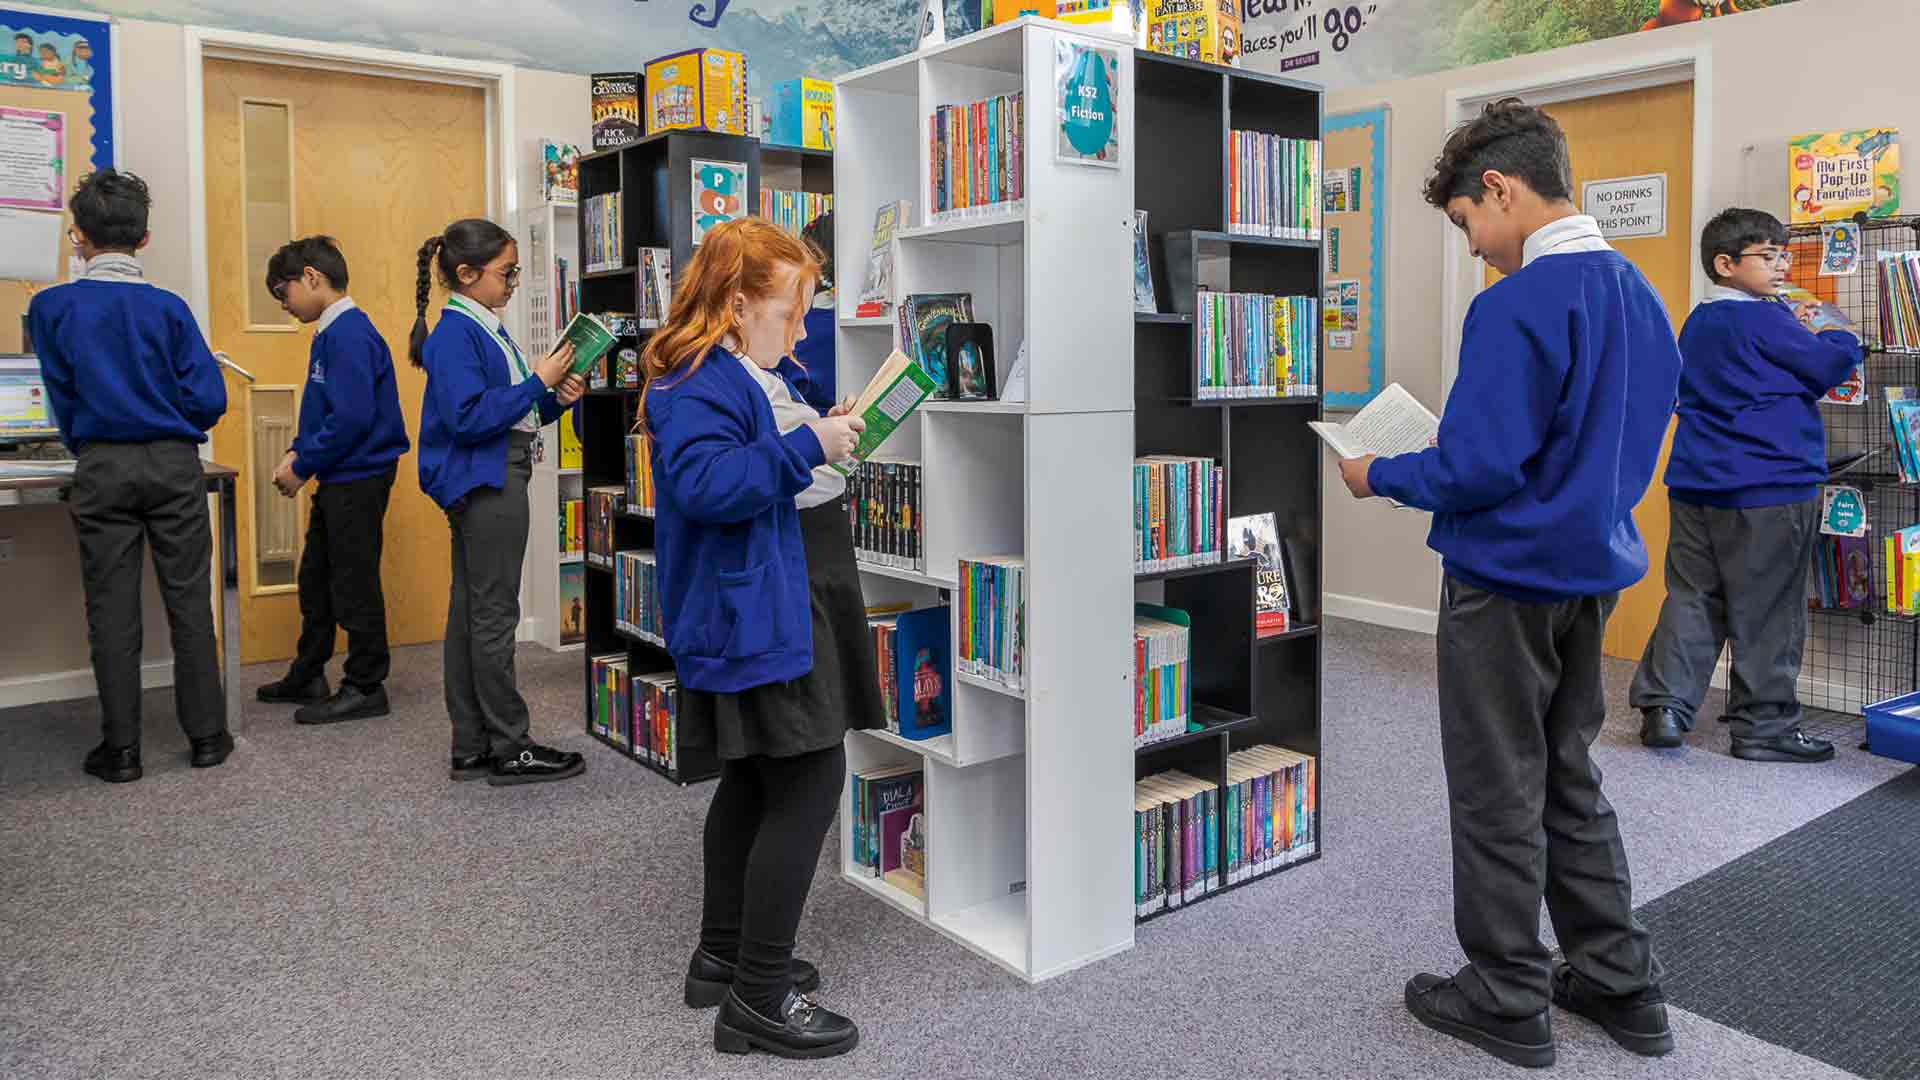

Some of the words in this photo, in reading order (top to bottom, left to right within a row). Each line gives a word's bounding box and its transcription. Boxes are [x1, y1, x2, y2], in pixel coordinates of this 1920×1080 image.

[1240, 33, 1277, 56] laces
[1280, 14, 1317, 52] you'll
[0, 63, 27, 80] ry
[1078, 86, 1098, 98] KS2
[1071, 105, 1105, 121] Fiction
[604, 128, 625, 137] RICK
[1816, 161, 1835, 173] My
[1839, 159, 1870, 172] First
[713, 173, 724, 187] P
[1596, 191, 1613, 204] NO
[1615, 187, 1653, 201] DRINKS
[1610, 203, 1636, 215] PAST
[1620, 215, 1652, 227] POINT
[1256, 570, 1281, 584] URE
